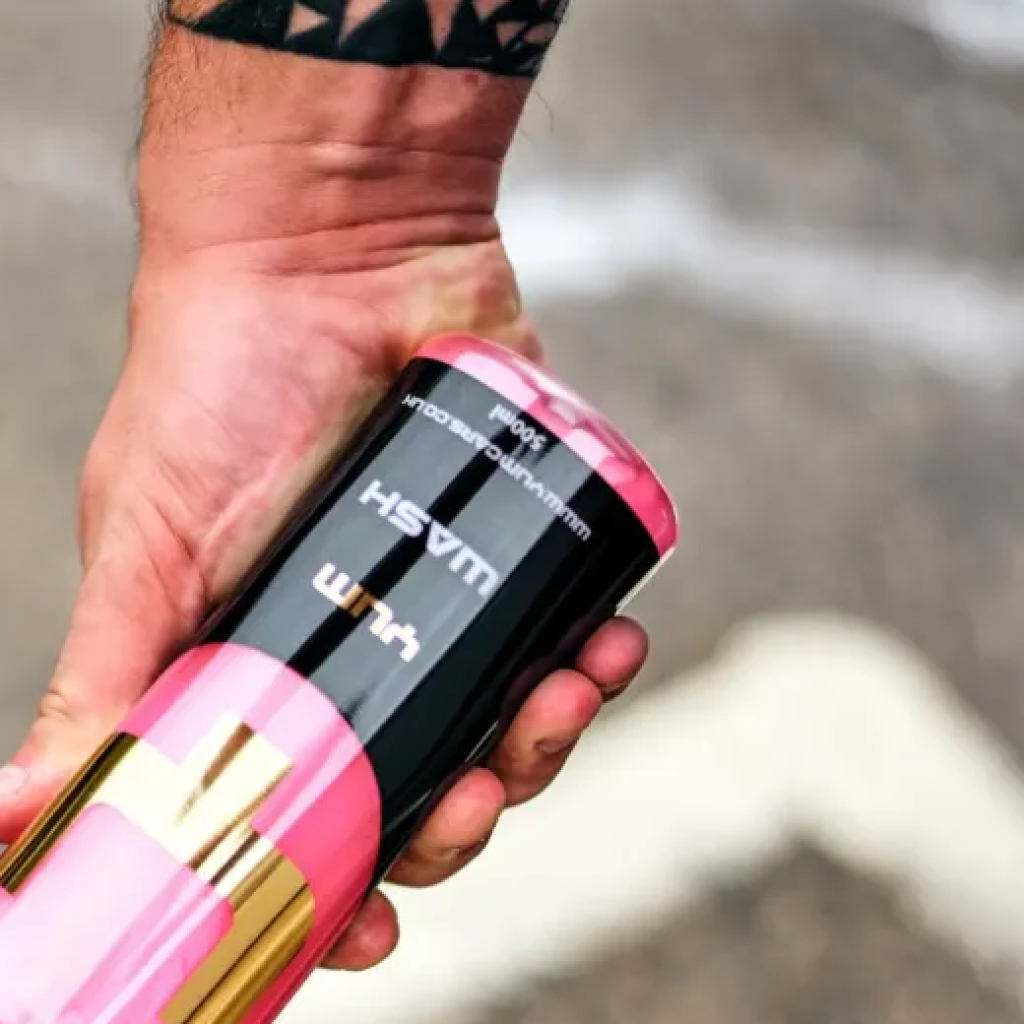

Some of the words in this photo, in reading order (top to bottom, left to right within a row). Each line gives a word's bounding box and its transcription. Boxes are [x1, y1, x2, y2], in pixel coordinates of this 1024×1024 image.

[488, 404, 548, 452] 500ml
[358, 479, 501, 598] WASH
[312, 563, 420, 662] YUM
